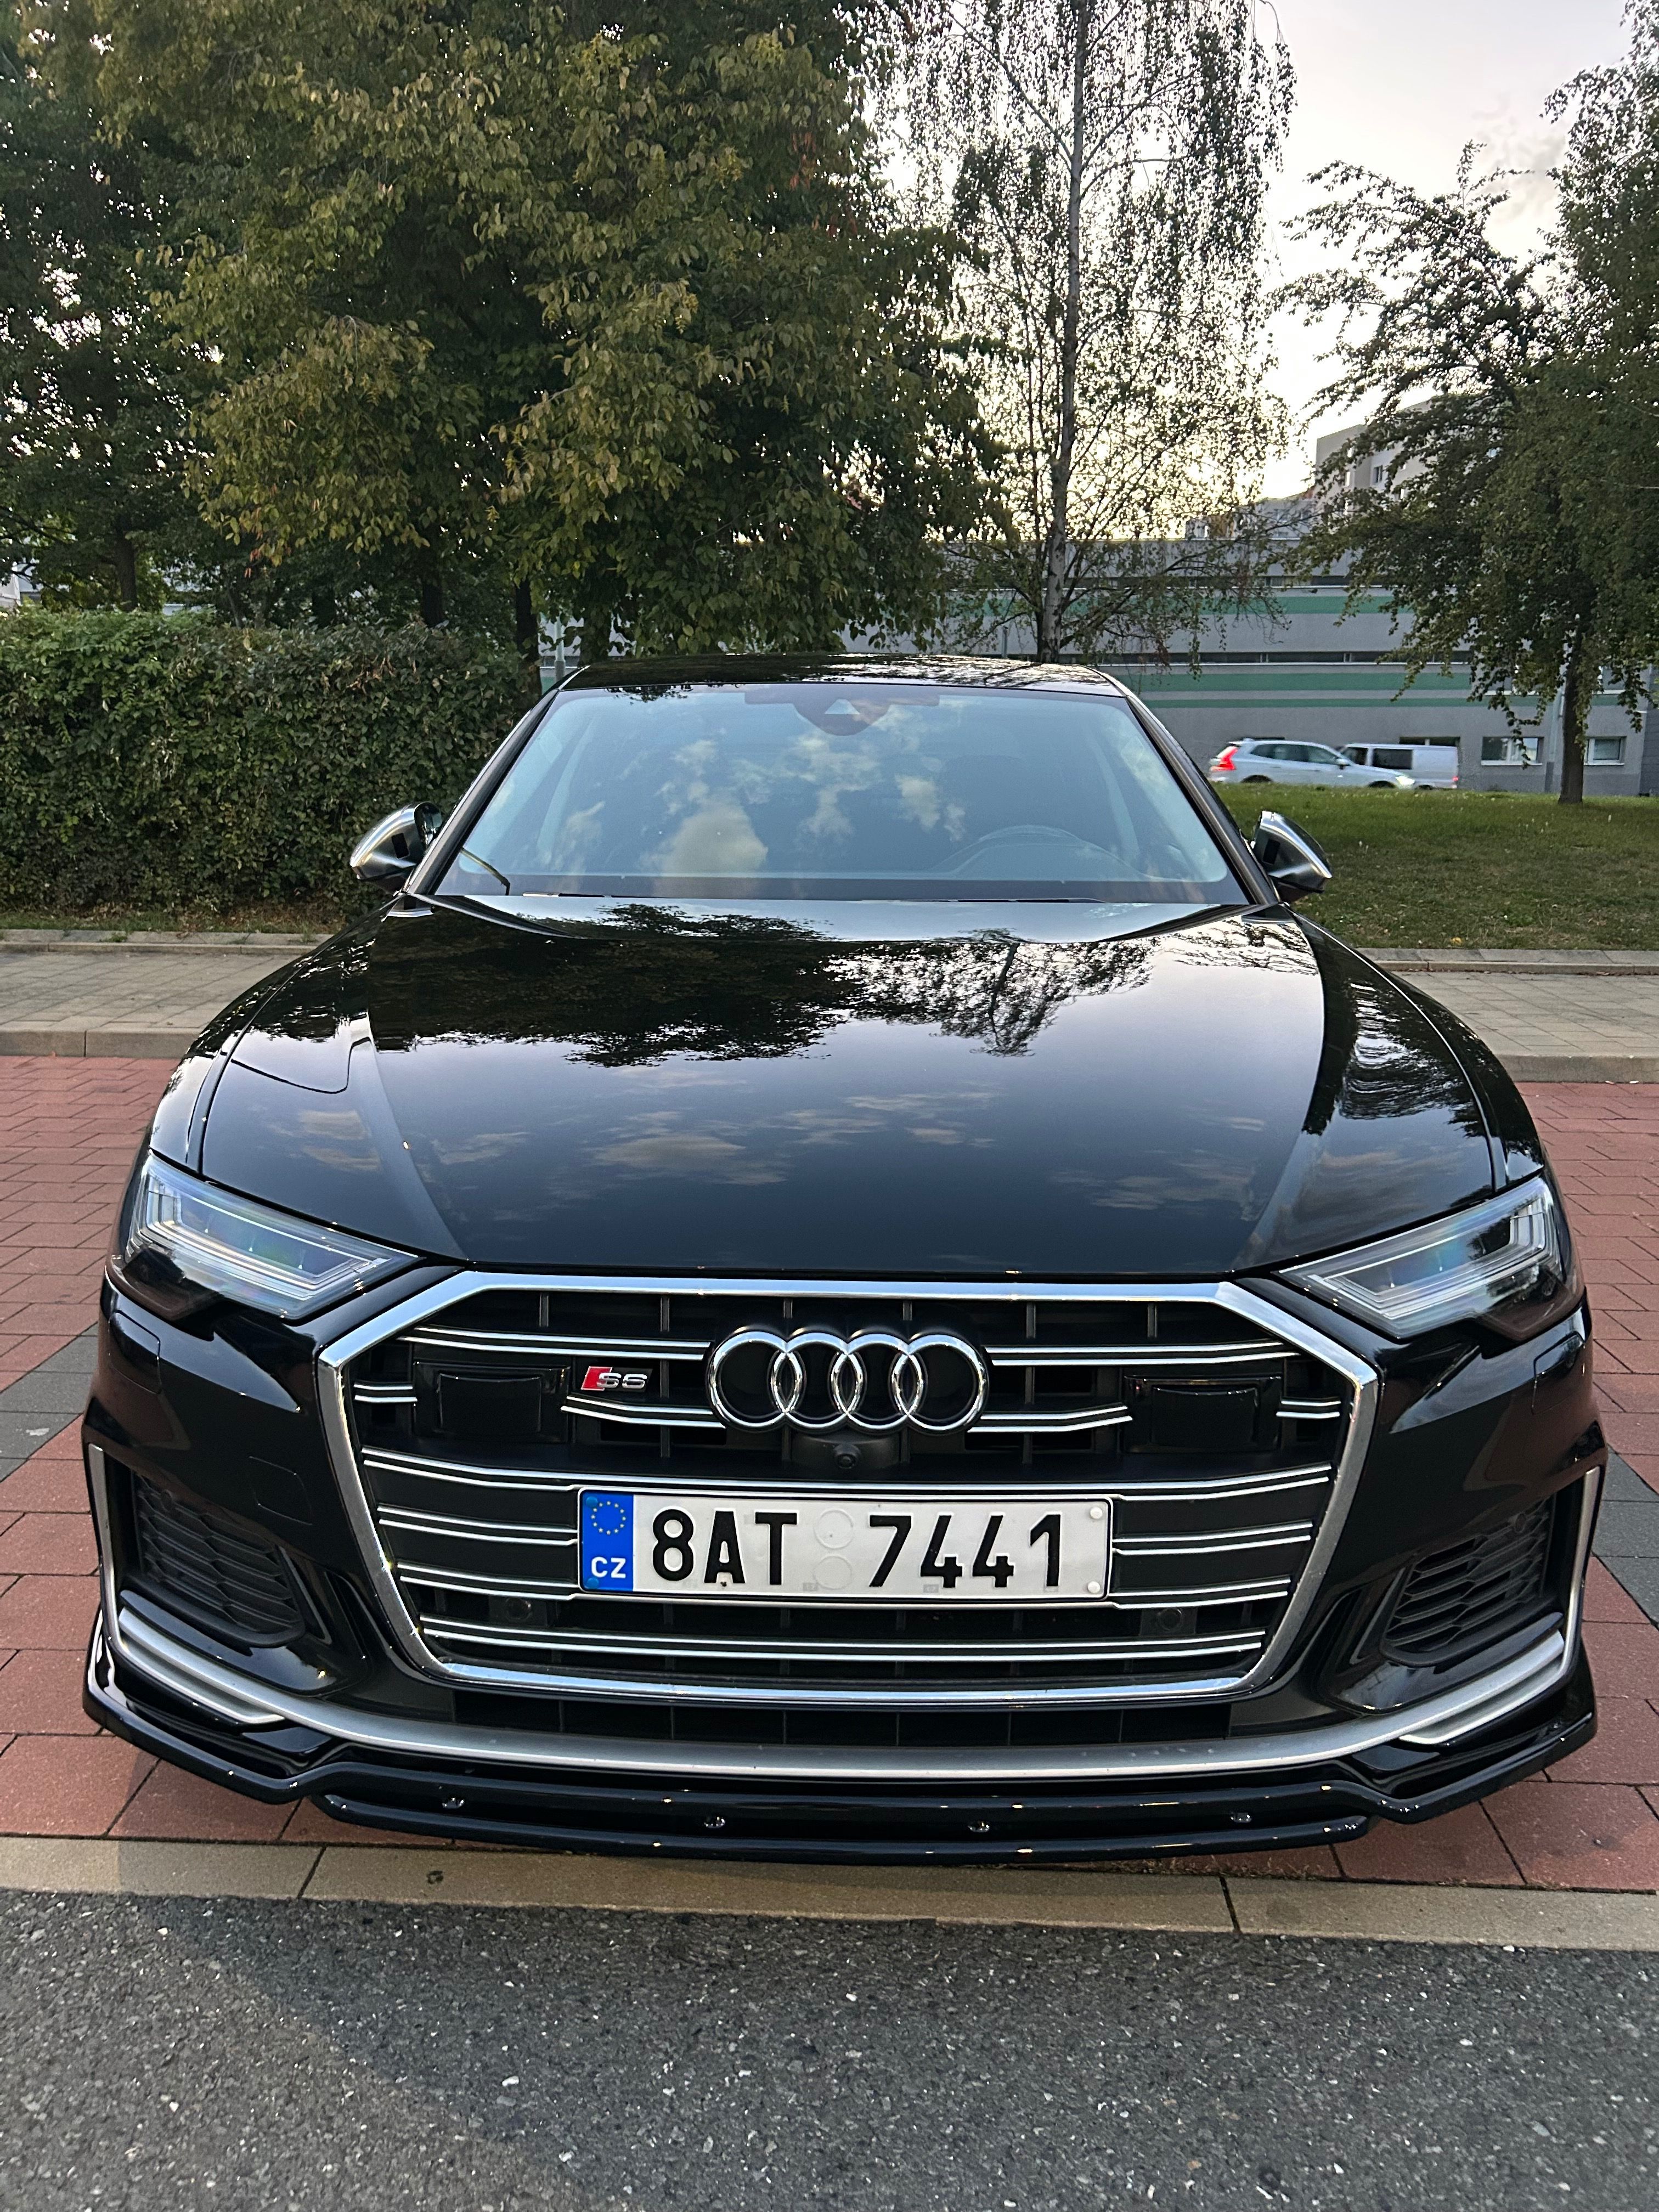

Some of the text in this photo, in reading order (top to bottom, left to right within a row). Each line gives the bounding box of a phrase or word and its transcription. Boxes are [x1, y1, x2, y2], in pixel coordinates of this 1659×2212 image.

[597, 1373, 647, 1389] S6
[653, 1509, 1060, 1588] 8AT 7441
[591, 1557, 626, 1578] CZ
